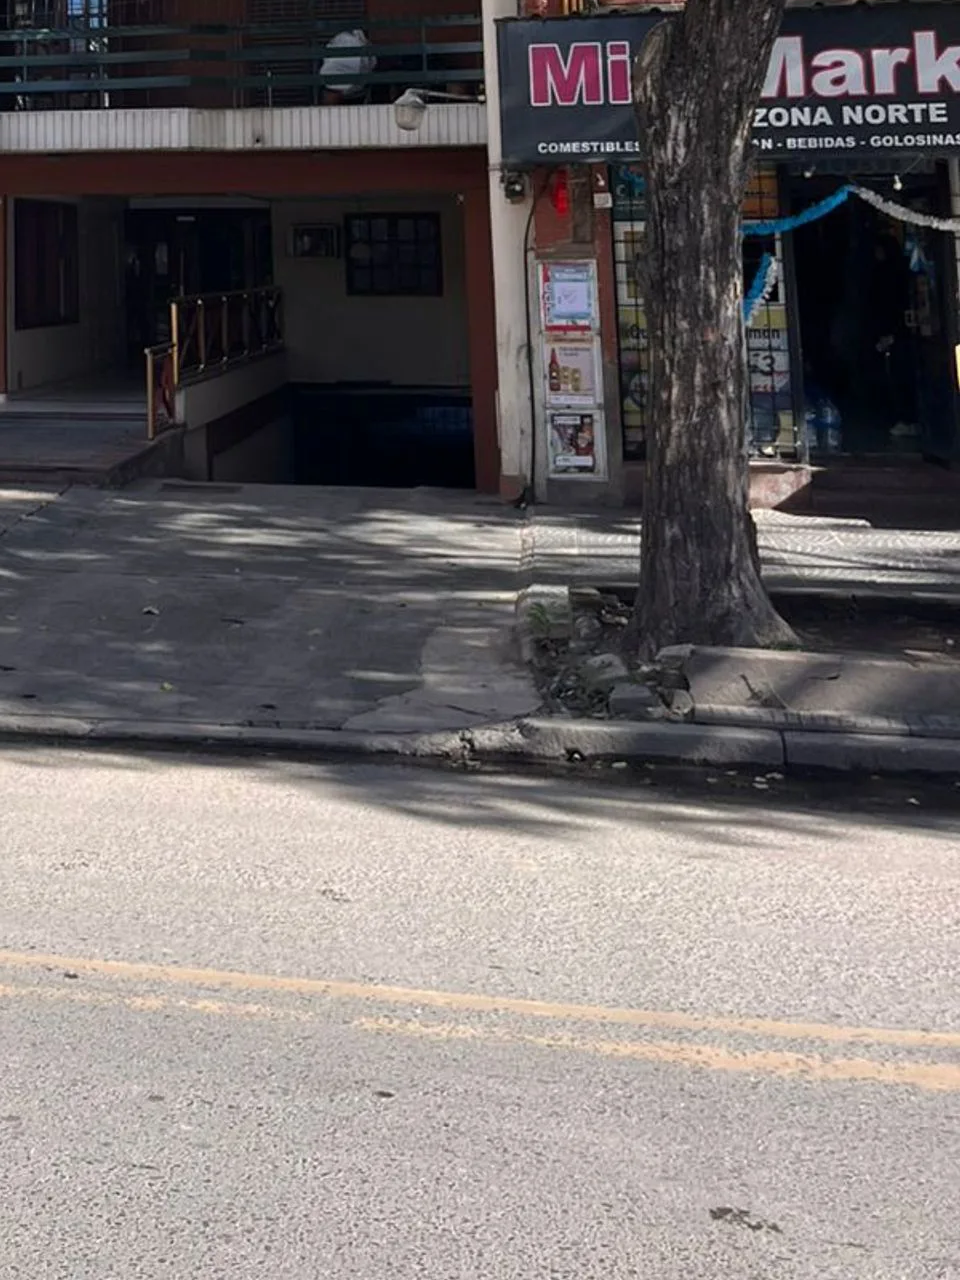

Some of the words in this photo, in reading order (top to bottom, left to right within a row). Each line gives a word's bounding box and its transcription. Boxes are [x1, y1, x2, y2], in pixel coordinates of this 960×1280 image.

[528, 41, 632, 106] Mi
[753, 106, 833, 127] ZONA
[842, 103, 948, 124] NORTE
[786, 136, 856, 149] BEBIDAS
